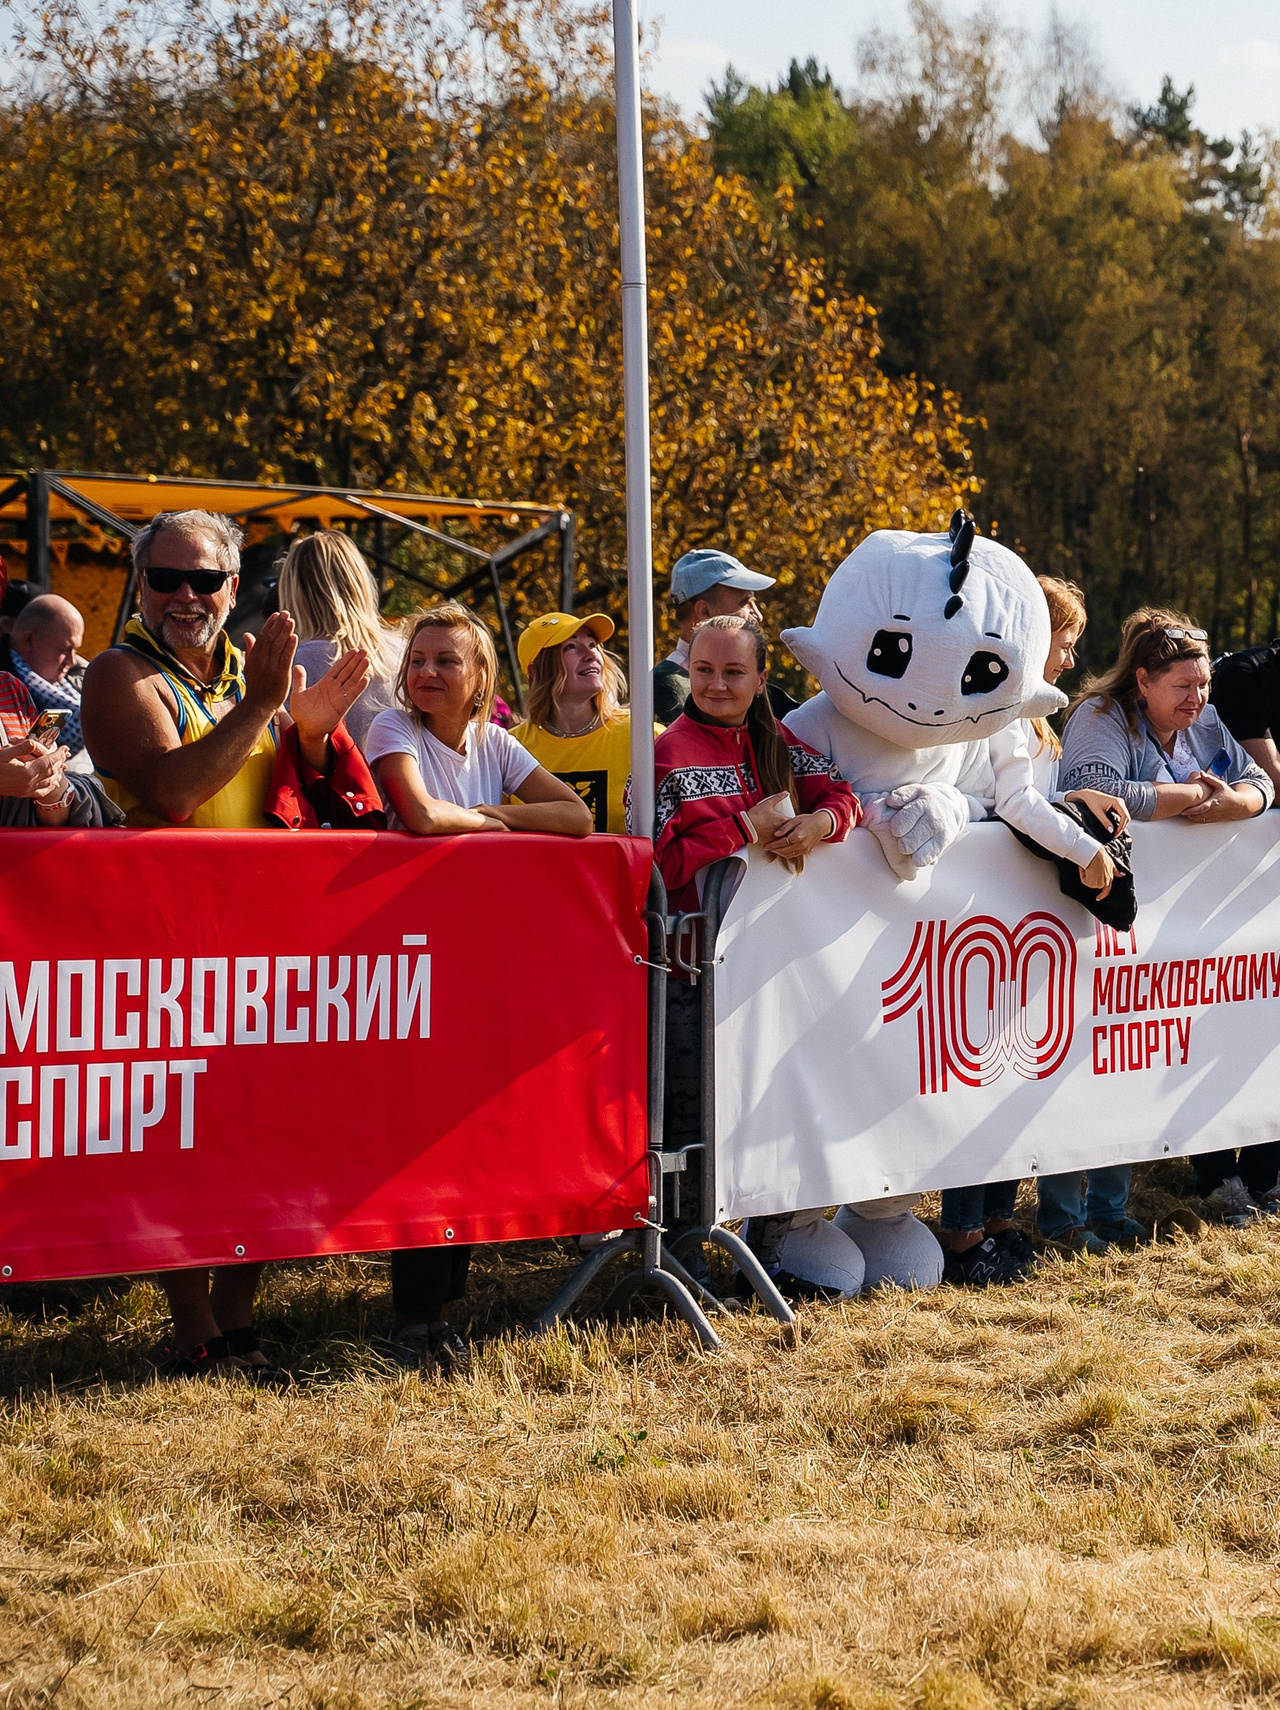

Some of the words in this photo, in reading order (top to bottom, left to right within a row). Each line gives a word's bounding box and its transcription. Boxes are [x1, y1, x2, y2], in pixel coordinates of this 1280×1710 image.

[0, 934, 432, 1054] МОСКОВСКИЙ
[881, 910, 1078, 1096] 100
[1092, 1016, 1192, 1075] СПОРТУ
[0, 1059, 207, 1160] СПОРТ
